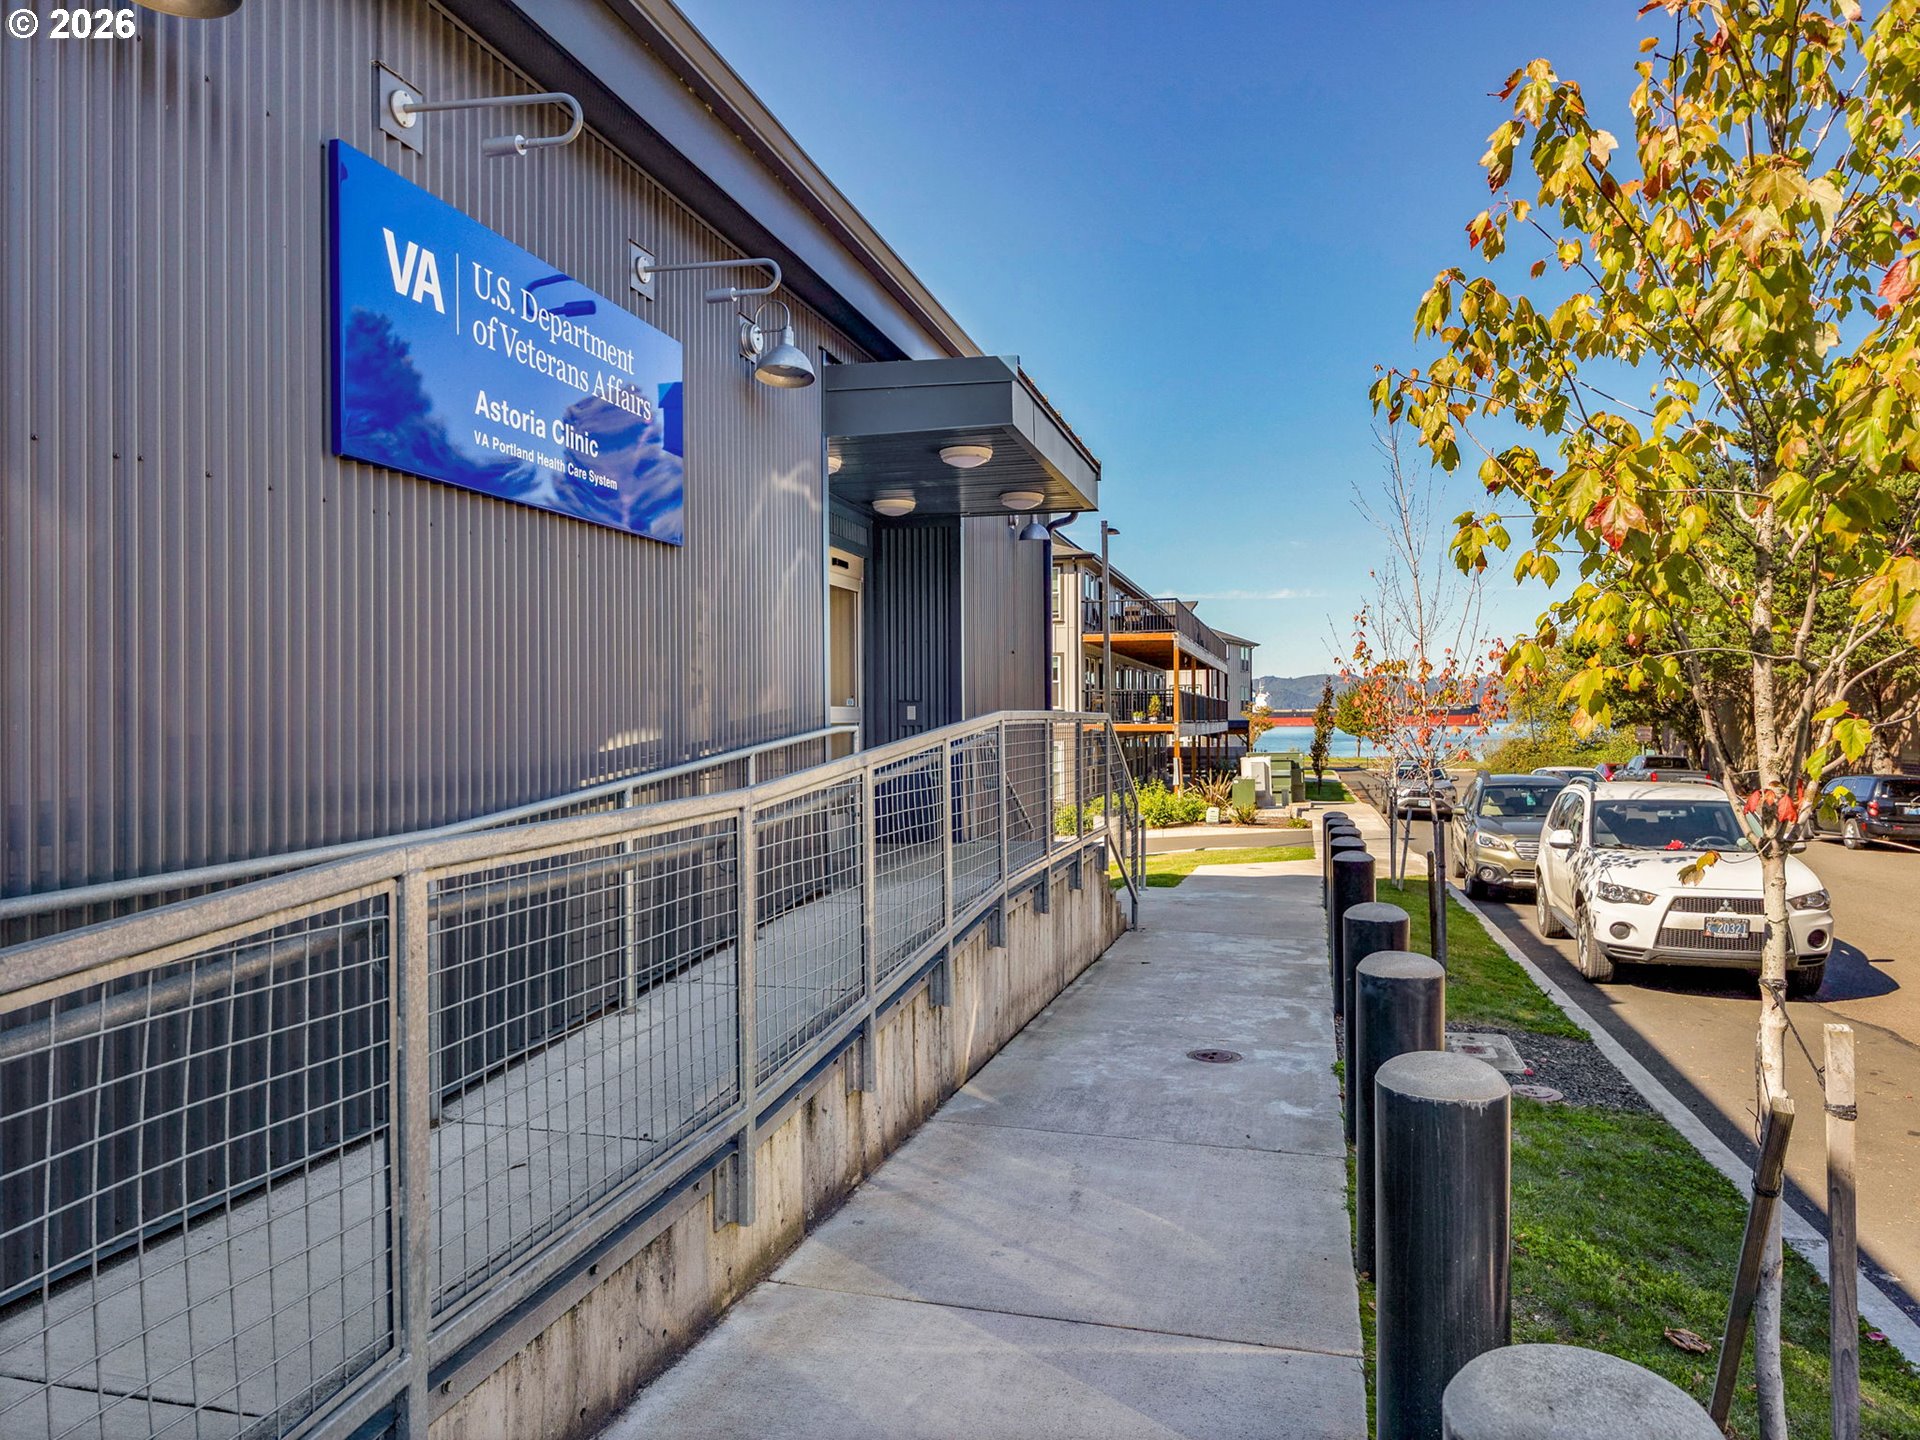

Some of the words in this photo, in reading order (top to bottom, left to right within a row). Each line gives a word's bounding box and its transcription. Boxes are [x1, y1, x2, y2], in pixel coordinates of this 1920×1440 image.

[382, 226, 446, 315] VA
[472, 261, 516, 315] U.S.
[520, 287, 635, 376] Department
[472, 316, 499, 351] of
[499, 321, 589, 393] Veterans
[592, 370, 652, 422] Affairs
[473, 429, 490, 449] VA
[492, 436, 535, 464] Portland
[536, 451, 566, 473] Health
[567, 462, 587, 480] Care
[588, 469, 618, 491] System
[474, 389, 546, 439] Astoria
[552, 419, 599, 458] Clinic
